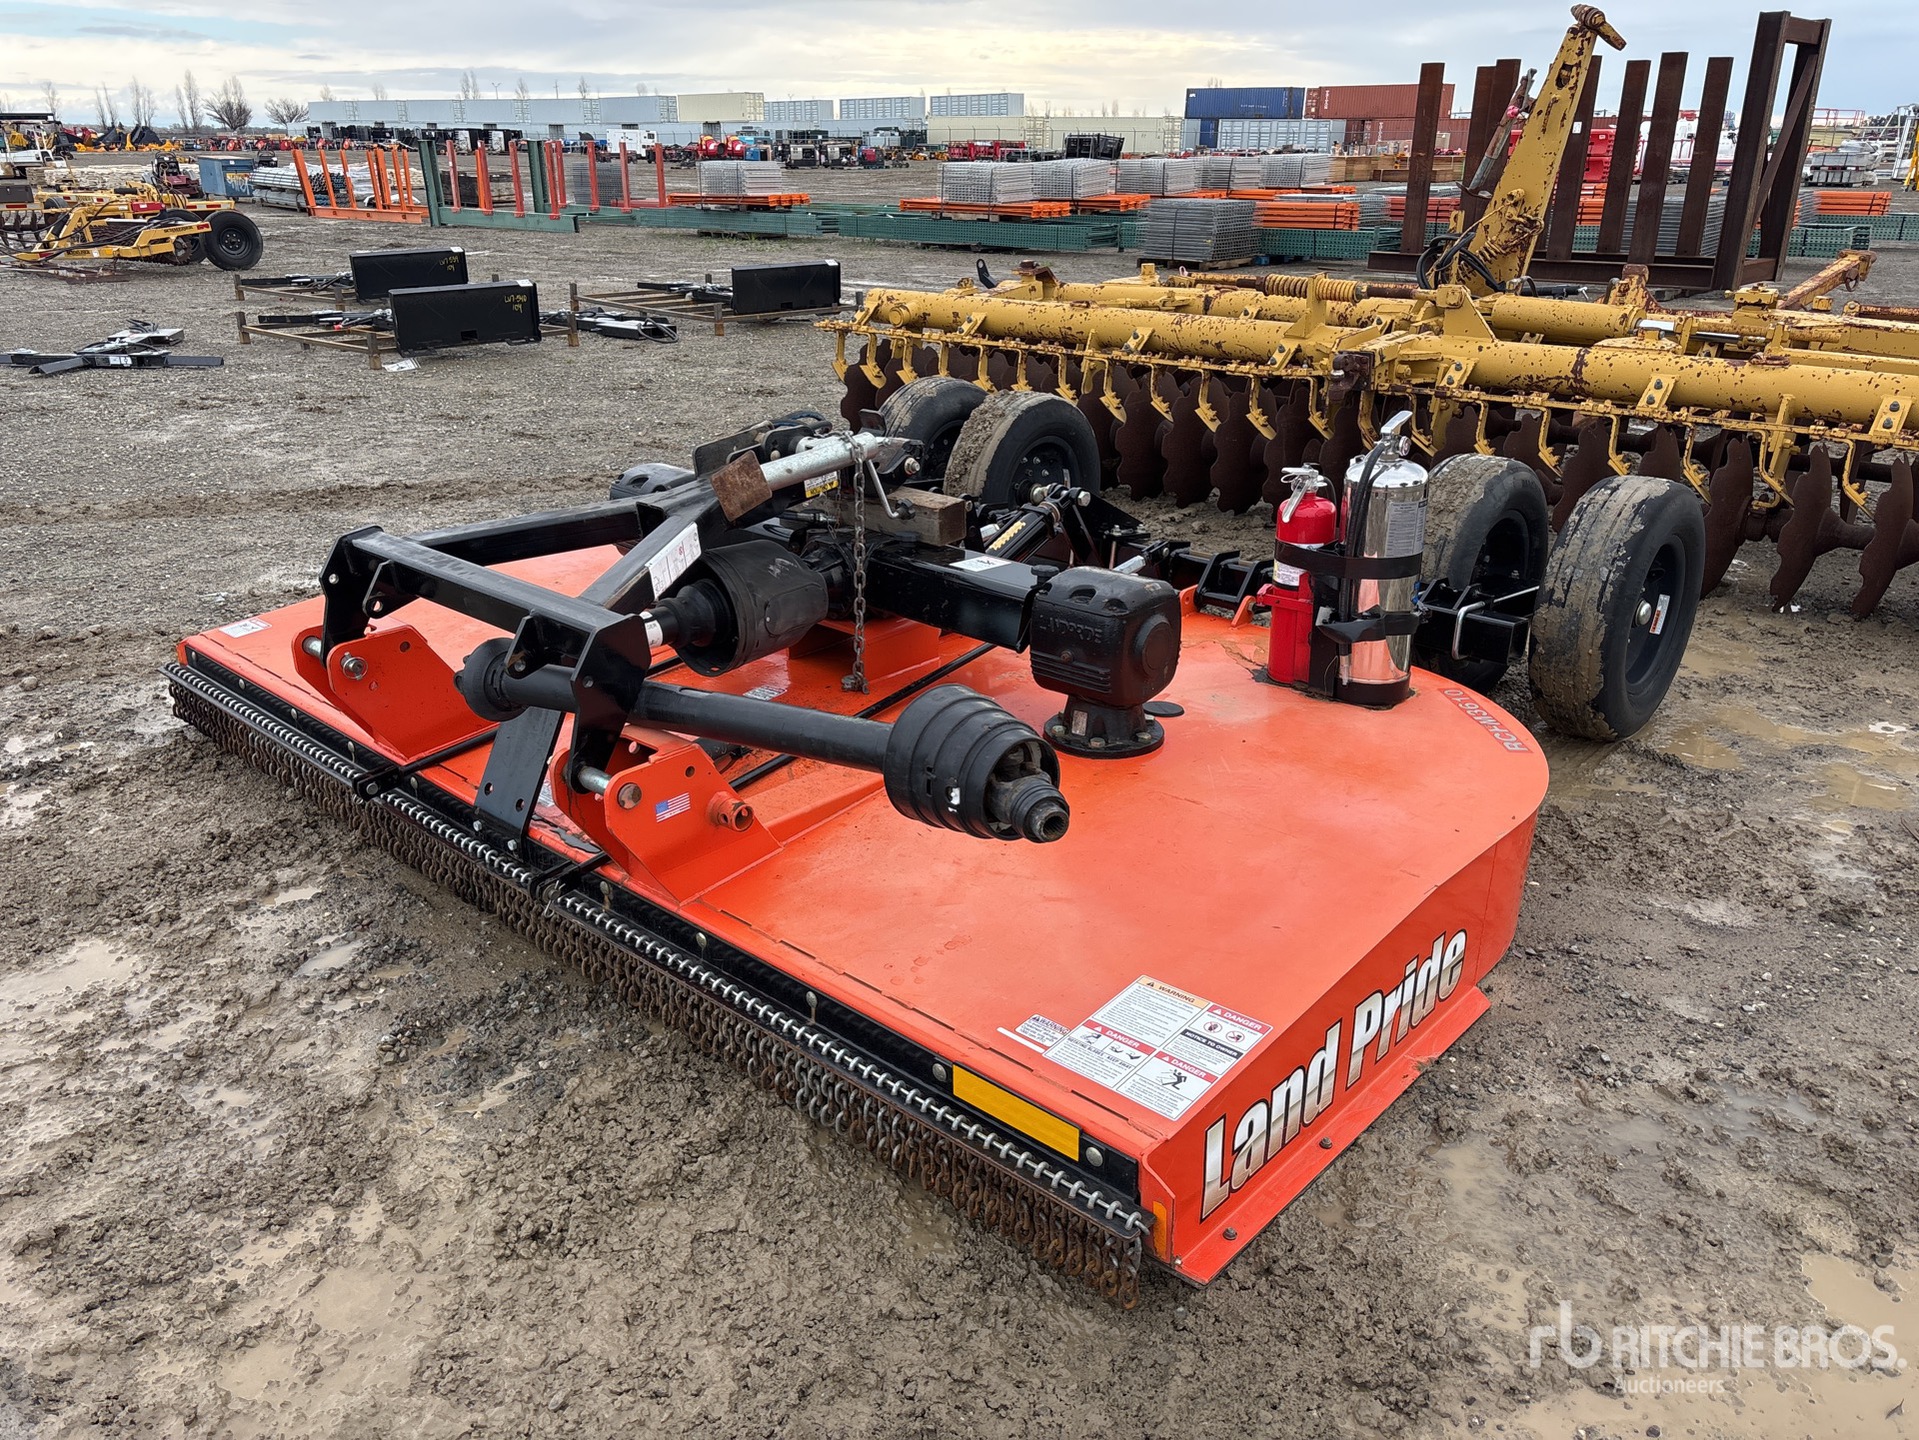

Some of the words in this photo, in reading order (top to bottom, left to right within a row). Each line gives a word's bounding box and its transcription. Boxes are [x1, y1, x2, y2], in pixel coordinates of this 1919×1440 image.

[1158, 985, 1195, 1003] WARNING
[1223, 1011, 1262, 1030] DANGER
[1105, 1030, 1140, 1048] DANGER
[1185, 1031, 1206, 1043] NOTICE
[1216, 1043, 1237, 1056] OWNER
[1171, 1058, 1207, 1078] DANGER
[1201, 1017, 1343, 1224] Land
[1346, 929, 1467, 1091] Pride
